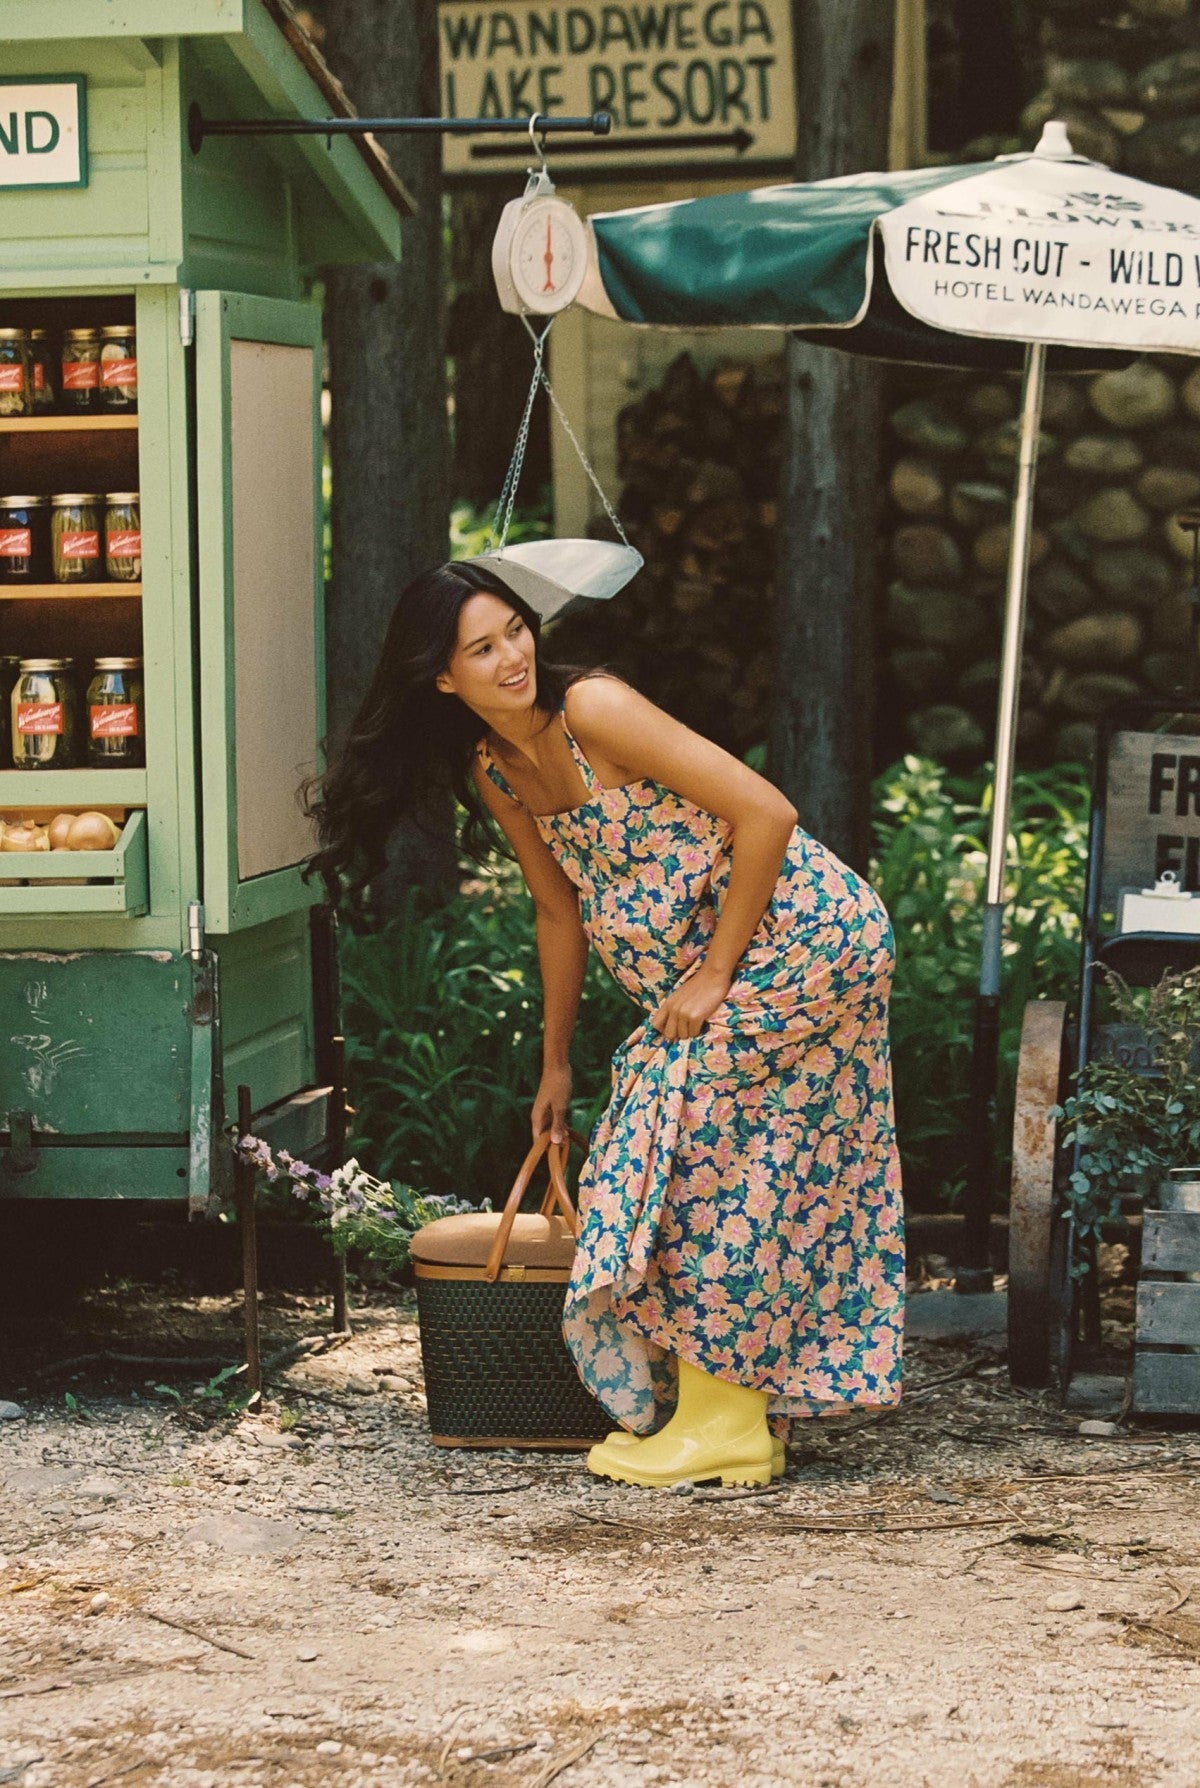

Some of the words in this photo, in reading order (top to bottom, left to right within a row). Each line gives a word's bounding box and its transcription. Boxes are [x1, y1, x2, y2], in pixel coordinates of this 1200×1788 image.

[445, 1, 774, 60] WANDAWEGA
[445, 65, 563, 133] LAKE
[588, 56, 776, 128] RESORT
[905, 226, 1002, 270] FRESH
[1013, 238, 1069, 277] CUT
[1110, 248, 1183, 287] WILD
[934, 280, 1014, 302] HOTEL
[1022, 288, 1187, 318] WANDAWEGA
